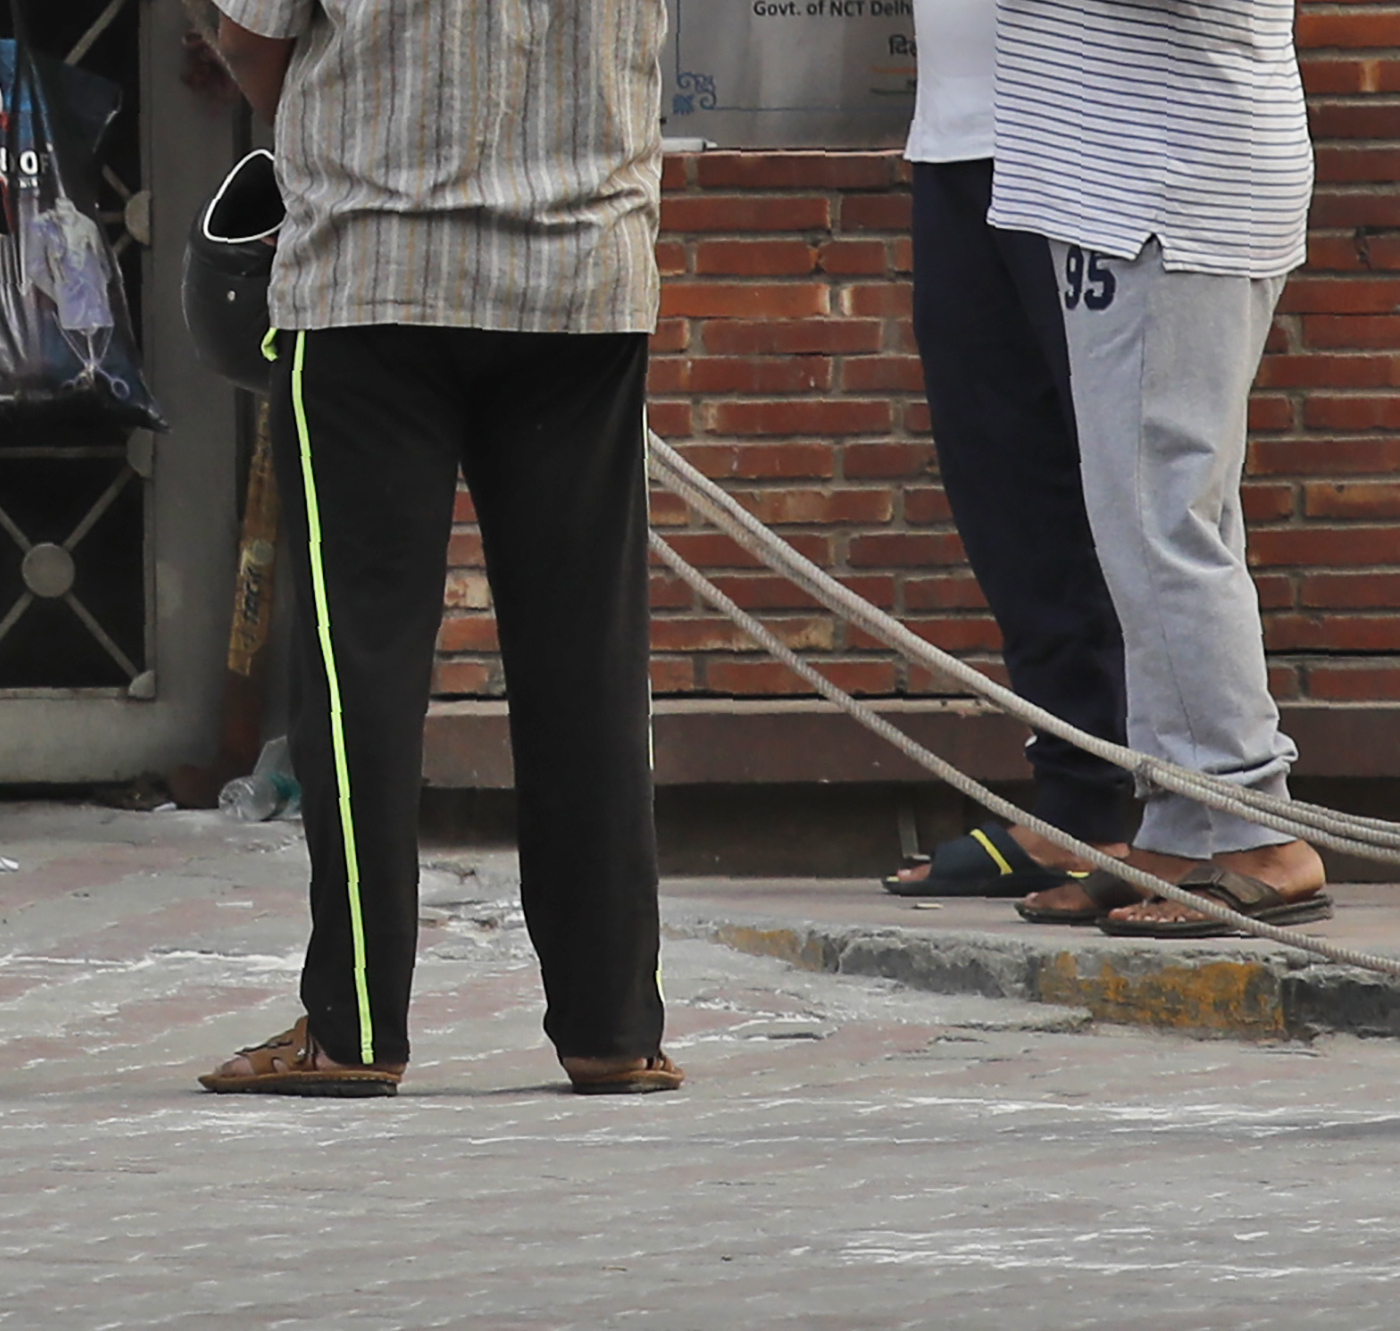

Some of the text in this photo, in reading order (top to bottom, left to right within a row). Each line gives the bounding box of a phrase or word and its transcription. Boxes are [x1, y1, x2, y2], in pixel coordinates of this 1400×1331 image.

[754, 0, 913, 16] Govt. of NCT Delh
[1064, 245, 1116, 311] 95
